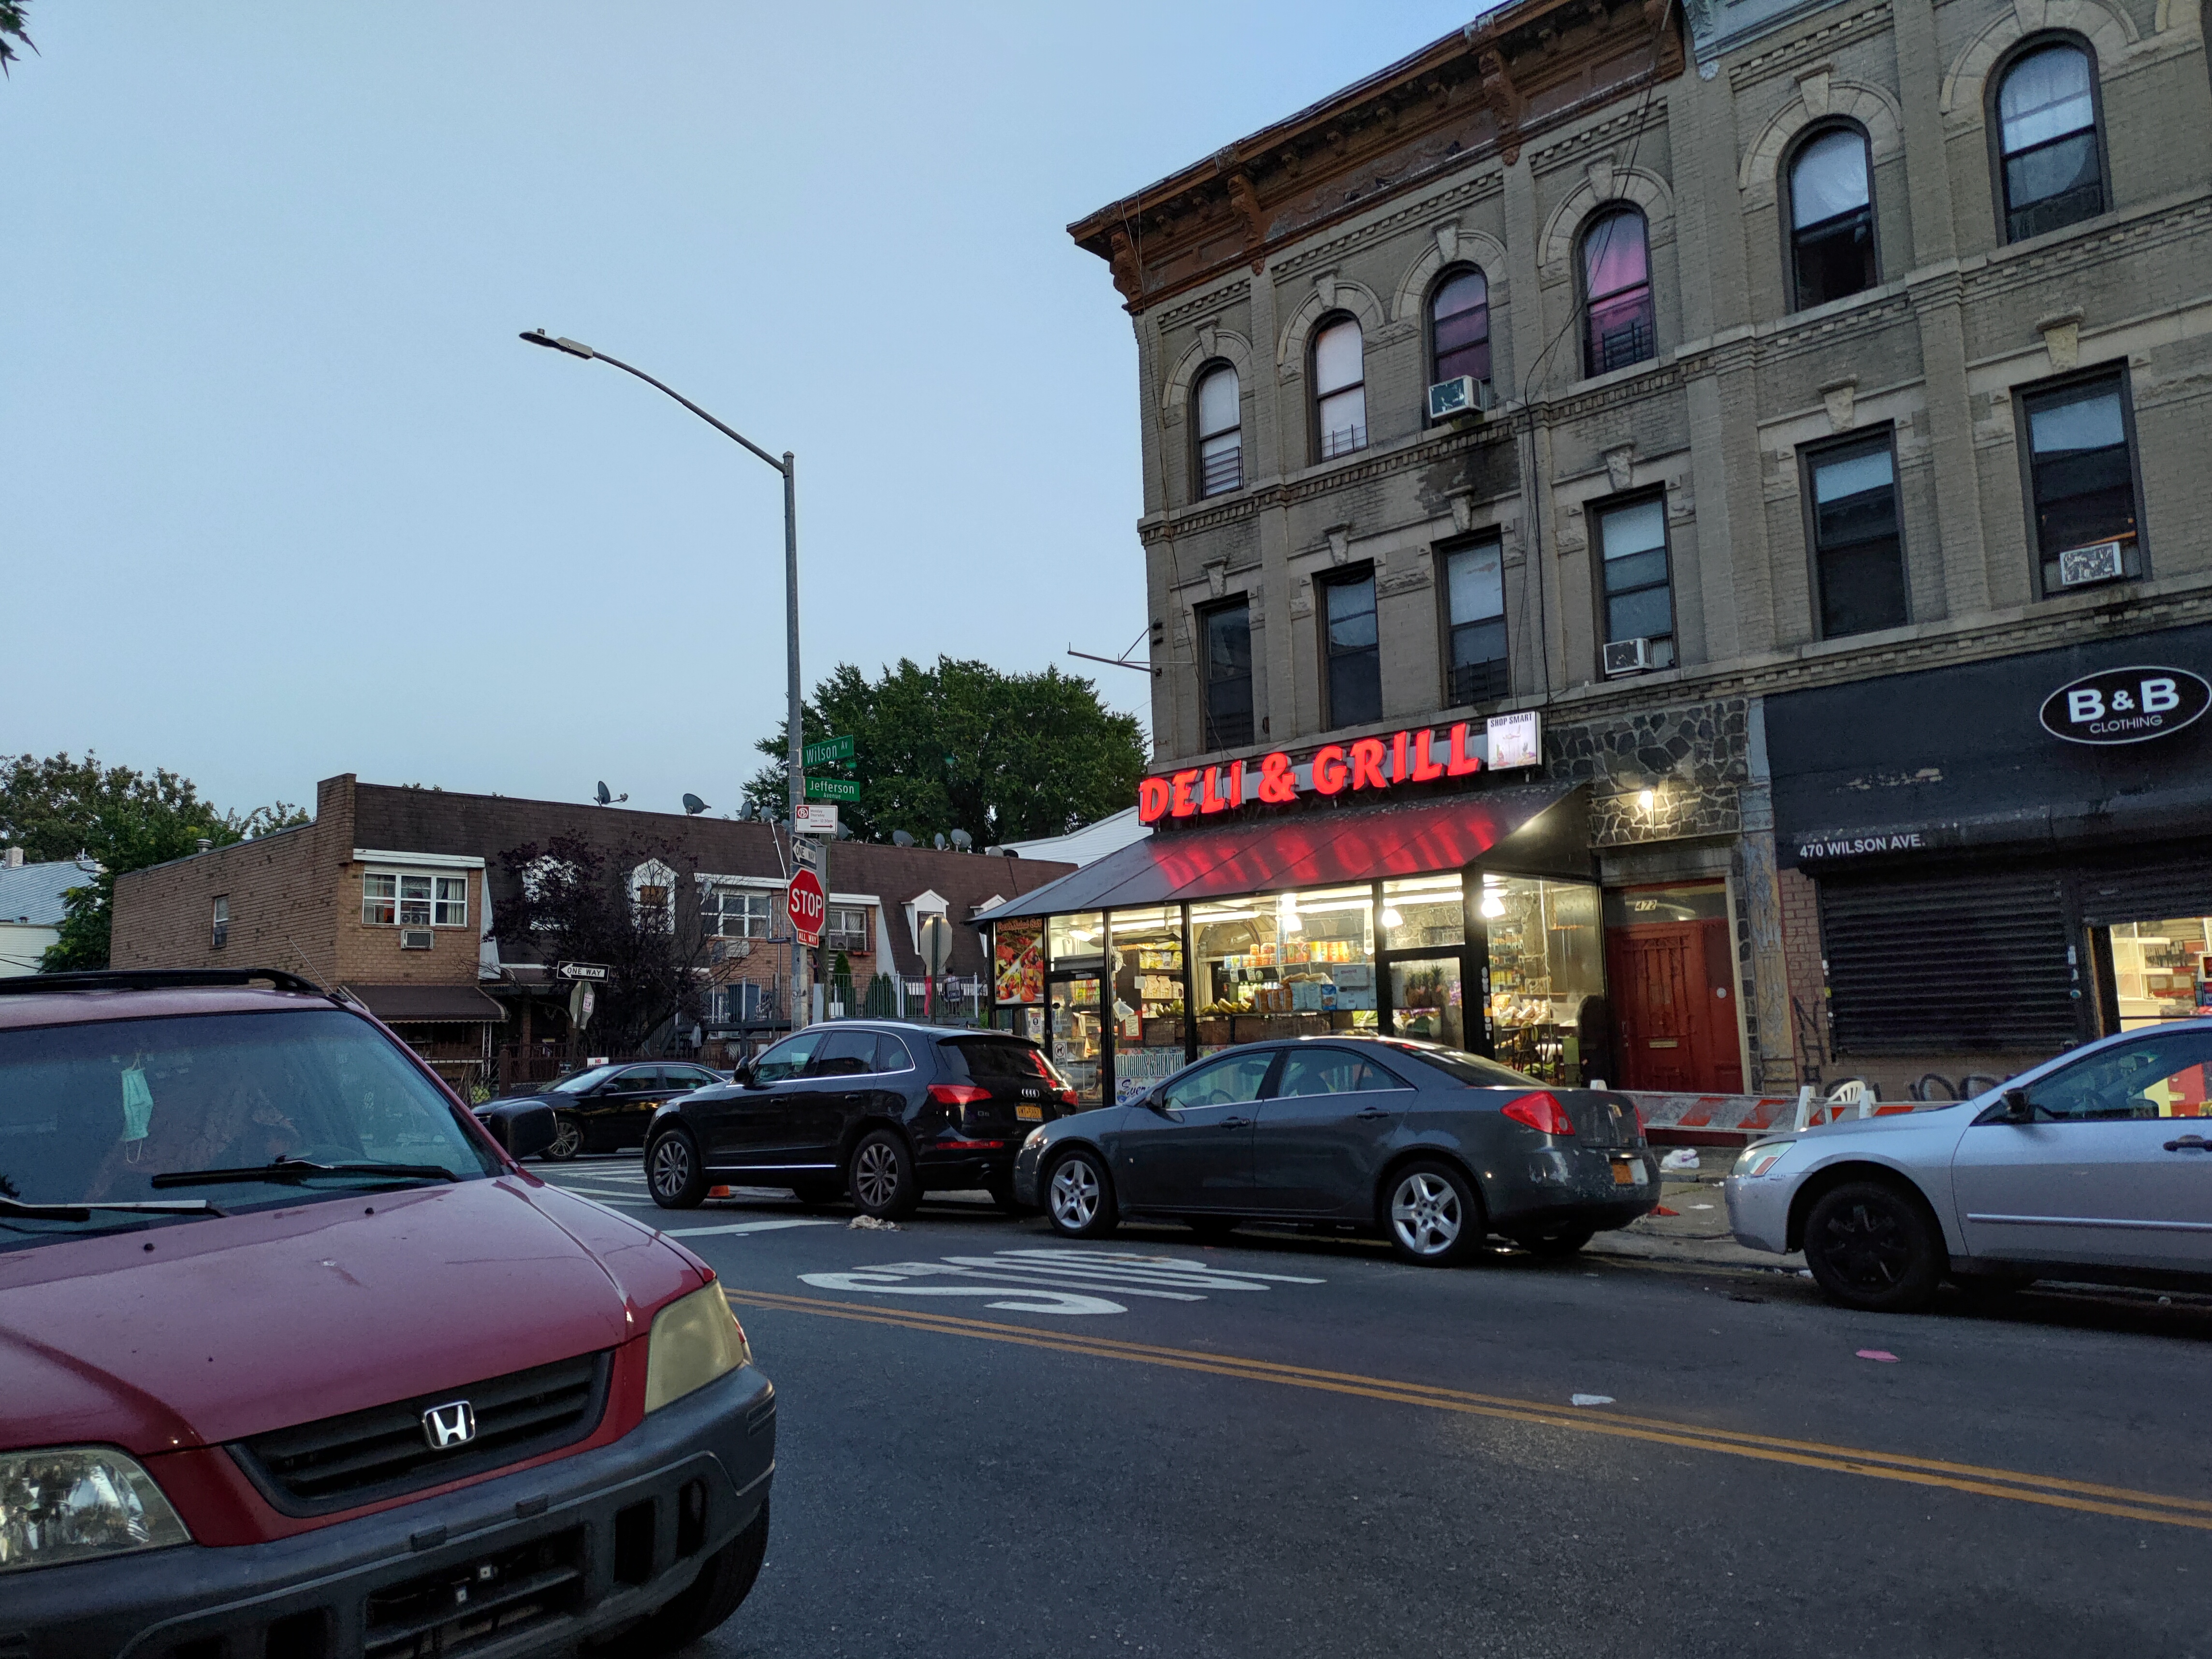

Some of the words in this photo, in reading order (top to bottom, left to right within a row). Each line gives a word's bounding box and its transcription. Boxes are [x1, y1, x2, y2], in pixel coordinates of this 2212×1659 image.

[1490, 717, 1507, 728] SHOP
[1509, 713, 1533, 724] SMART
[2090, 715, 2163, 734] CLOTHING
[806, 744, 837, 764] Wilson
[1138, 759, 1243, 822] DELI
[1258, 752, 1295, 803] &
[1312, 722, 1478, 795] GRILL
[810, 780, 855, 794] Jefferson
[796, 845, 804, 857] ONE
[1800, 844, 1823, 858] 470
[1827, 837, 1886, 856] WILSON
[1891, 834, 1926, 849] AVE.
[791, 888, 822, 918] STOP
[1636, 901, 1656, 910] 472
[808, 934, 817, 944] WAY
[1116, 1055, 1148, 1076] DELICIOUS
[1150, 1055, 1155, 1076] &
